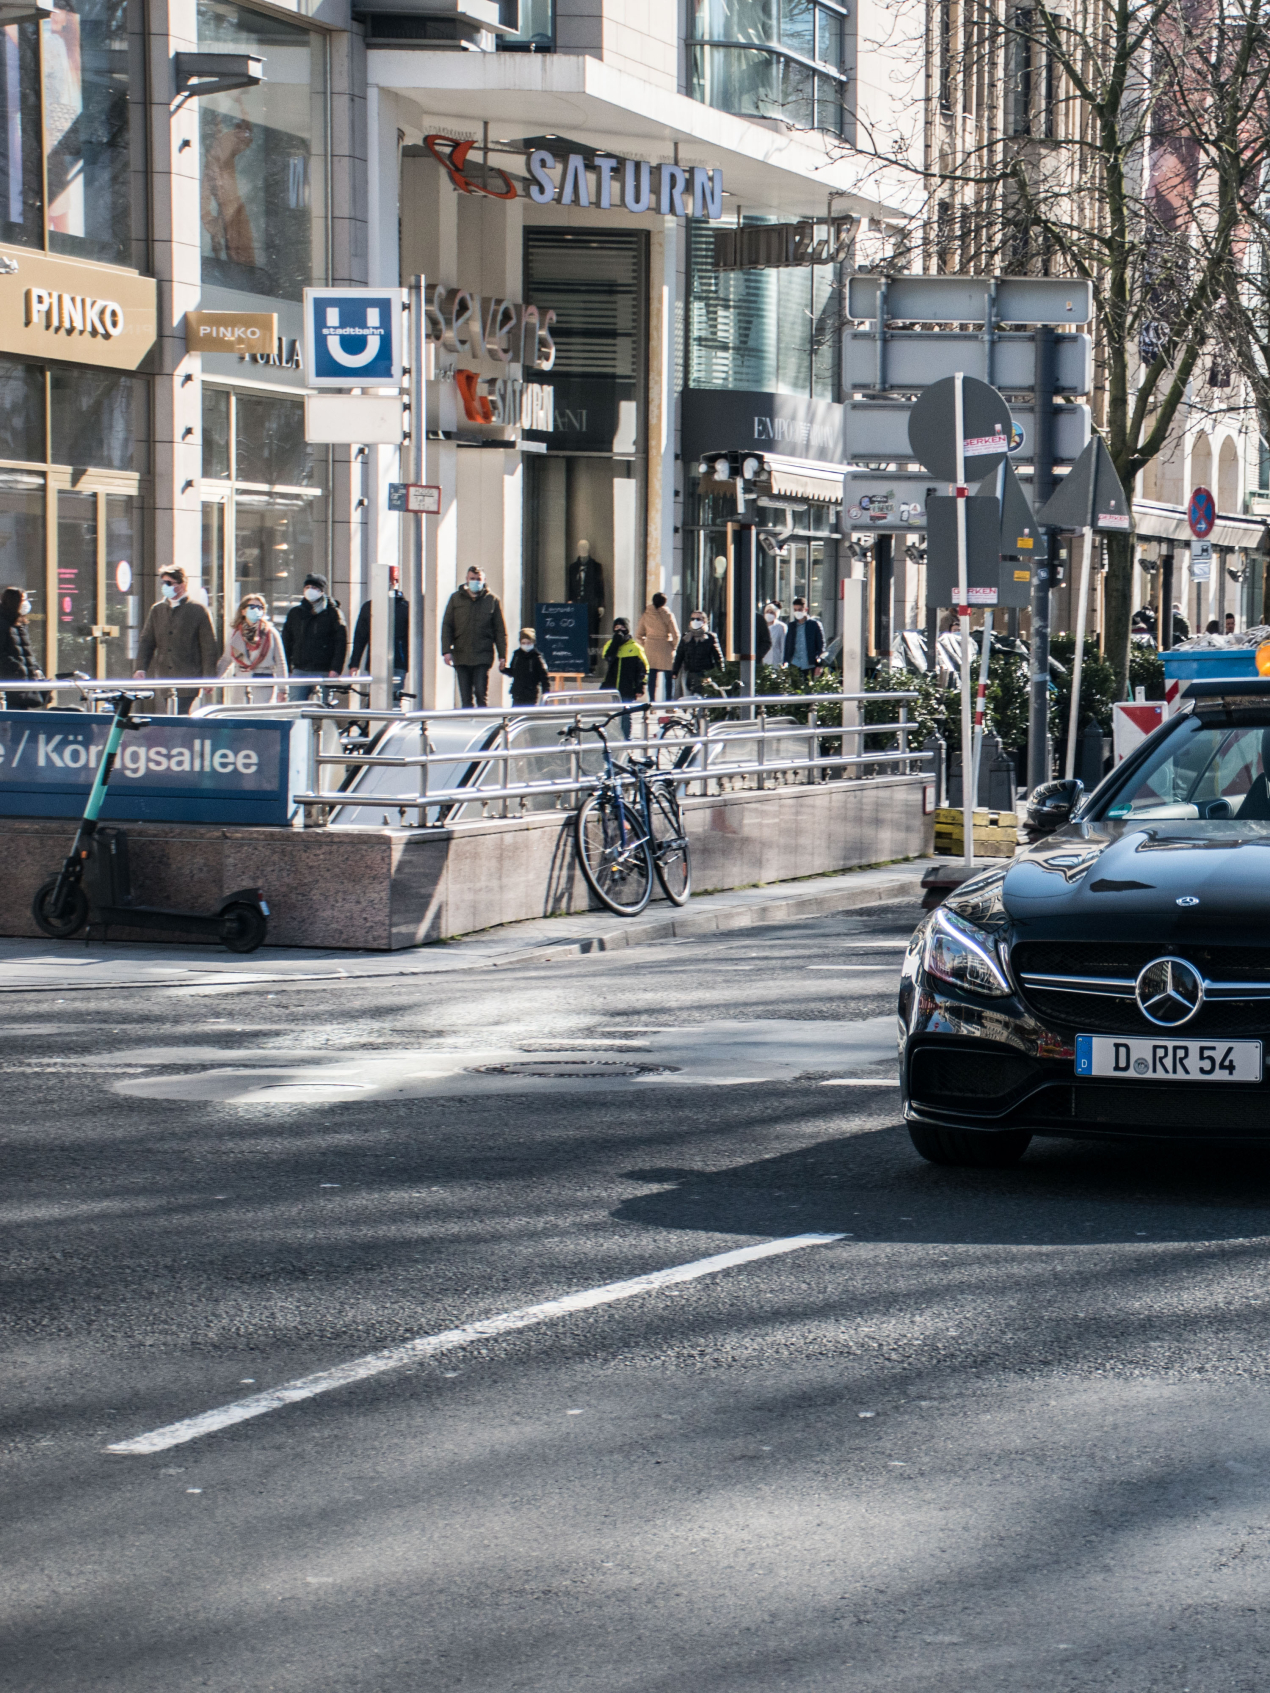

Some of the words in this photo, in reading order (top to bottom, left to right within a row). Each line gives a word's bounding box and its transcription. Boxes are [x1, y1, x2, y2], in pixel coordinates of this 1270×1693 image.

[526, 150, 723, 219] SATURN
[28, 288, 124, 337] PINKO
[200, 326, 260, 339] PINKO
[322, 326, 385, 335] stadtbahn
[488, 376, 554, 432] SATURN
[953, 587, 997, 595] GRKEN
[1081, 1059, 1088, 1068] D
[1113, 1042, 1131, 1073] D
[1152, 1044, 1190, 1075] RR
[1198, 1046, 1236, 1076] 54
